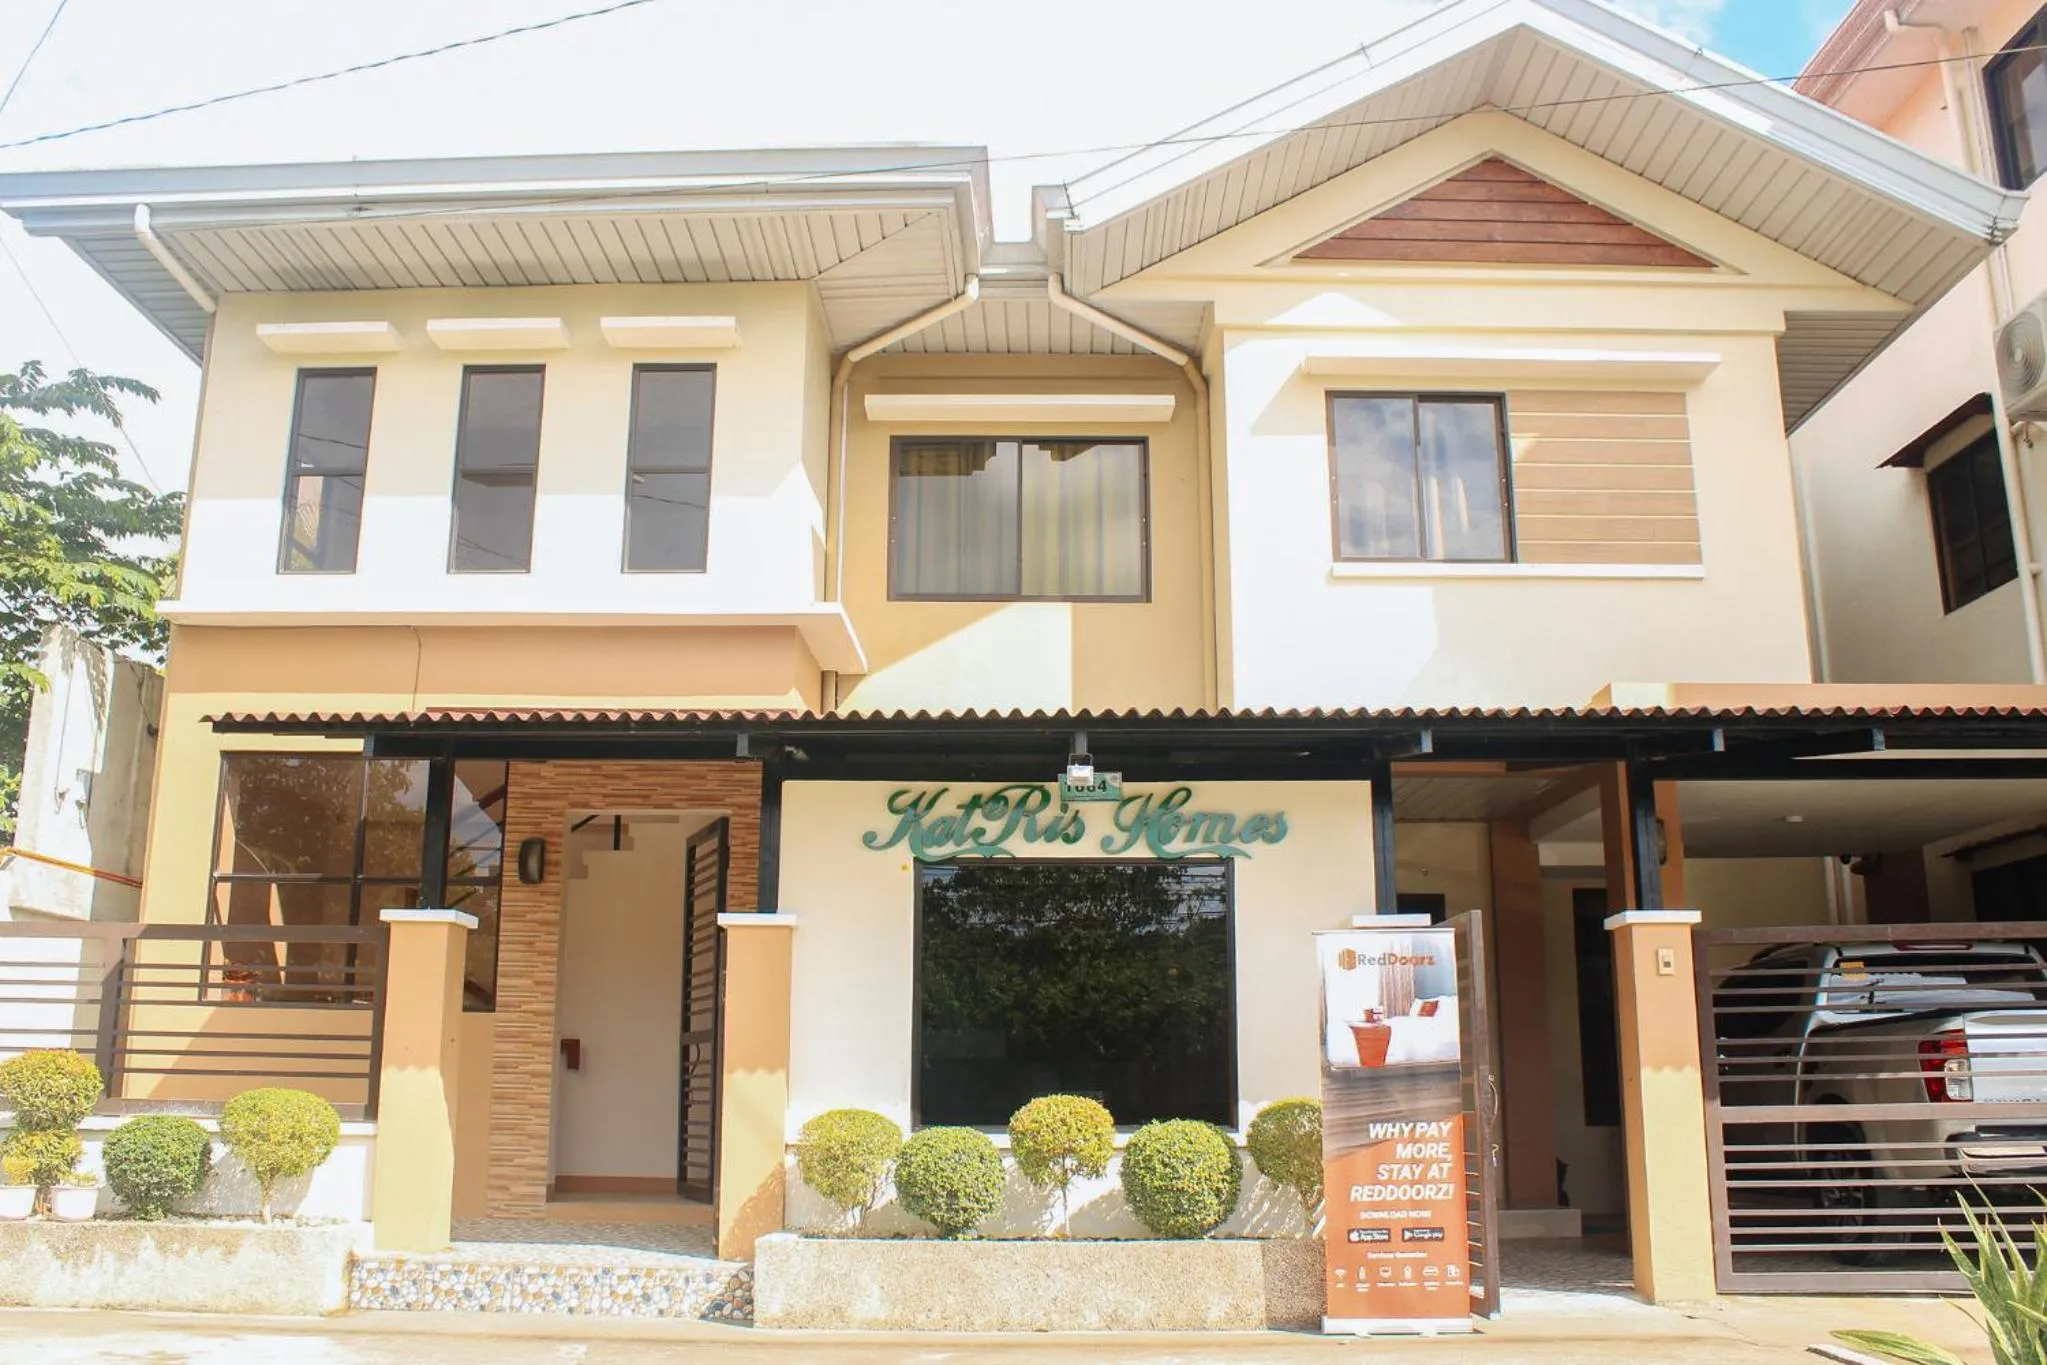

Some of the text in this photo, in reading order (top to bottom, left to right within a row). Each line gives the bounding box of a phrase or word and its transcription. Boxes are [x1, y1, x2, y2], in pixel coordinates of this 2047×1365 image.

[1100, 786, 1289, 861] Homes
[1357, 952, 1435, 966] RedDoorz
[1368, 1121, 1453, 1139] WHY PAY
[1395, 1142, 1453, 1161] MORE,
[1376, 1162, 1453, 1180] STAY AT
[1349, 1183, 1456, 1202] REDDOORZ!
